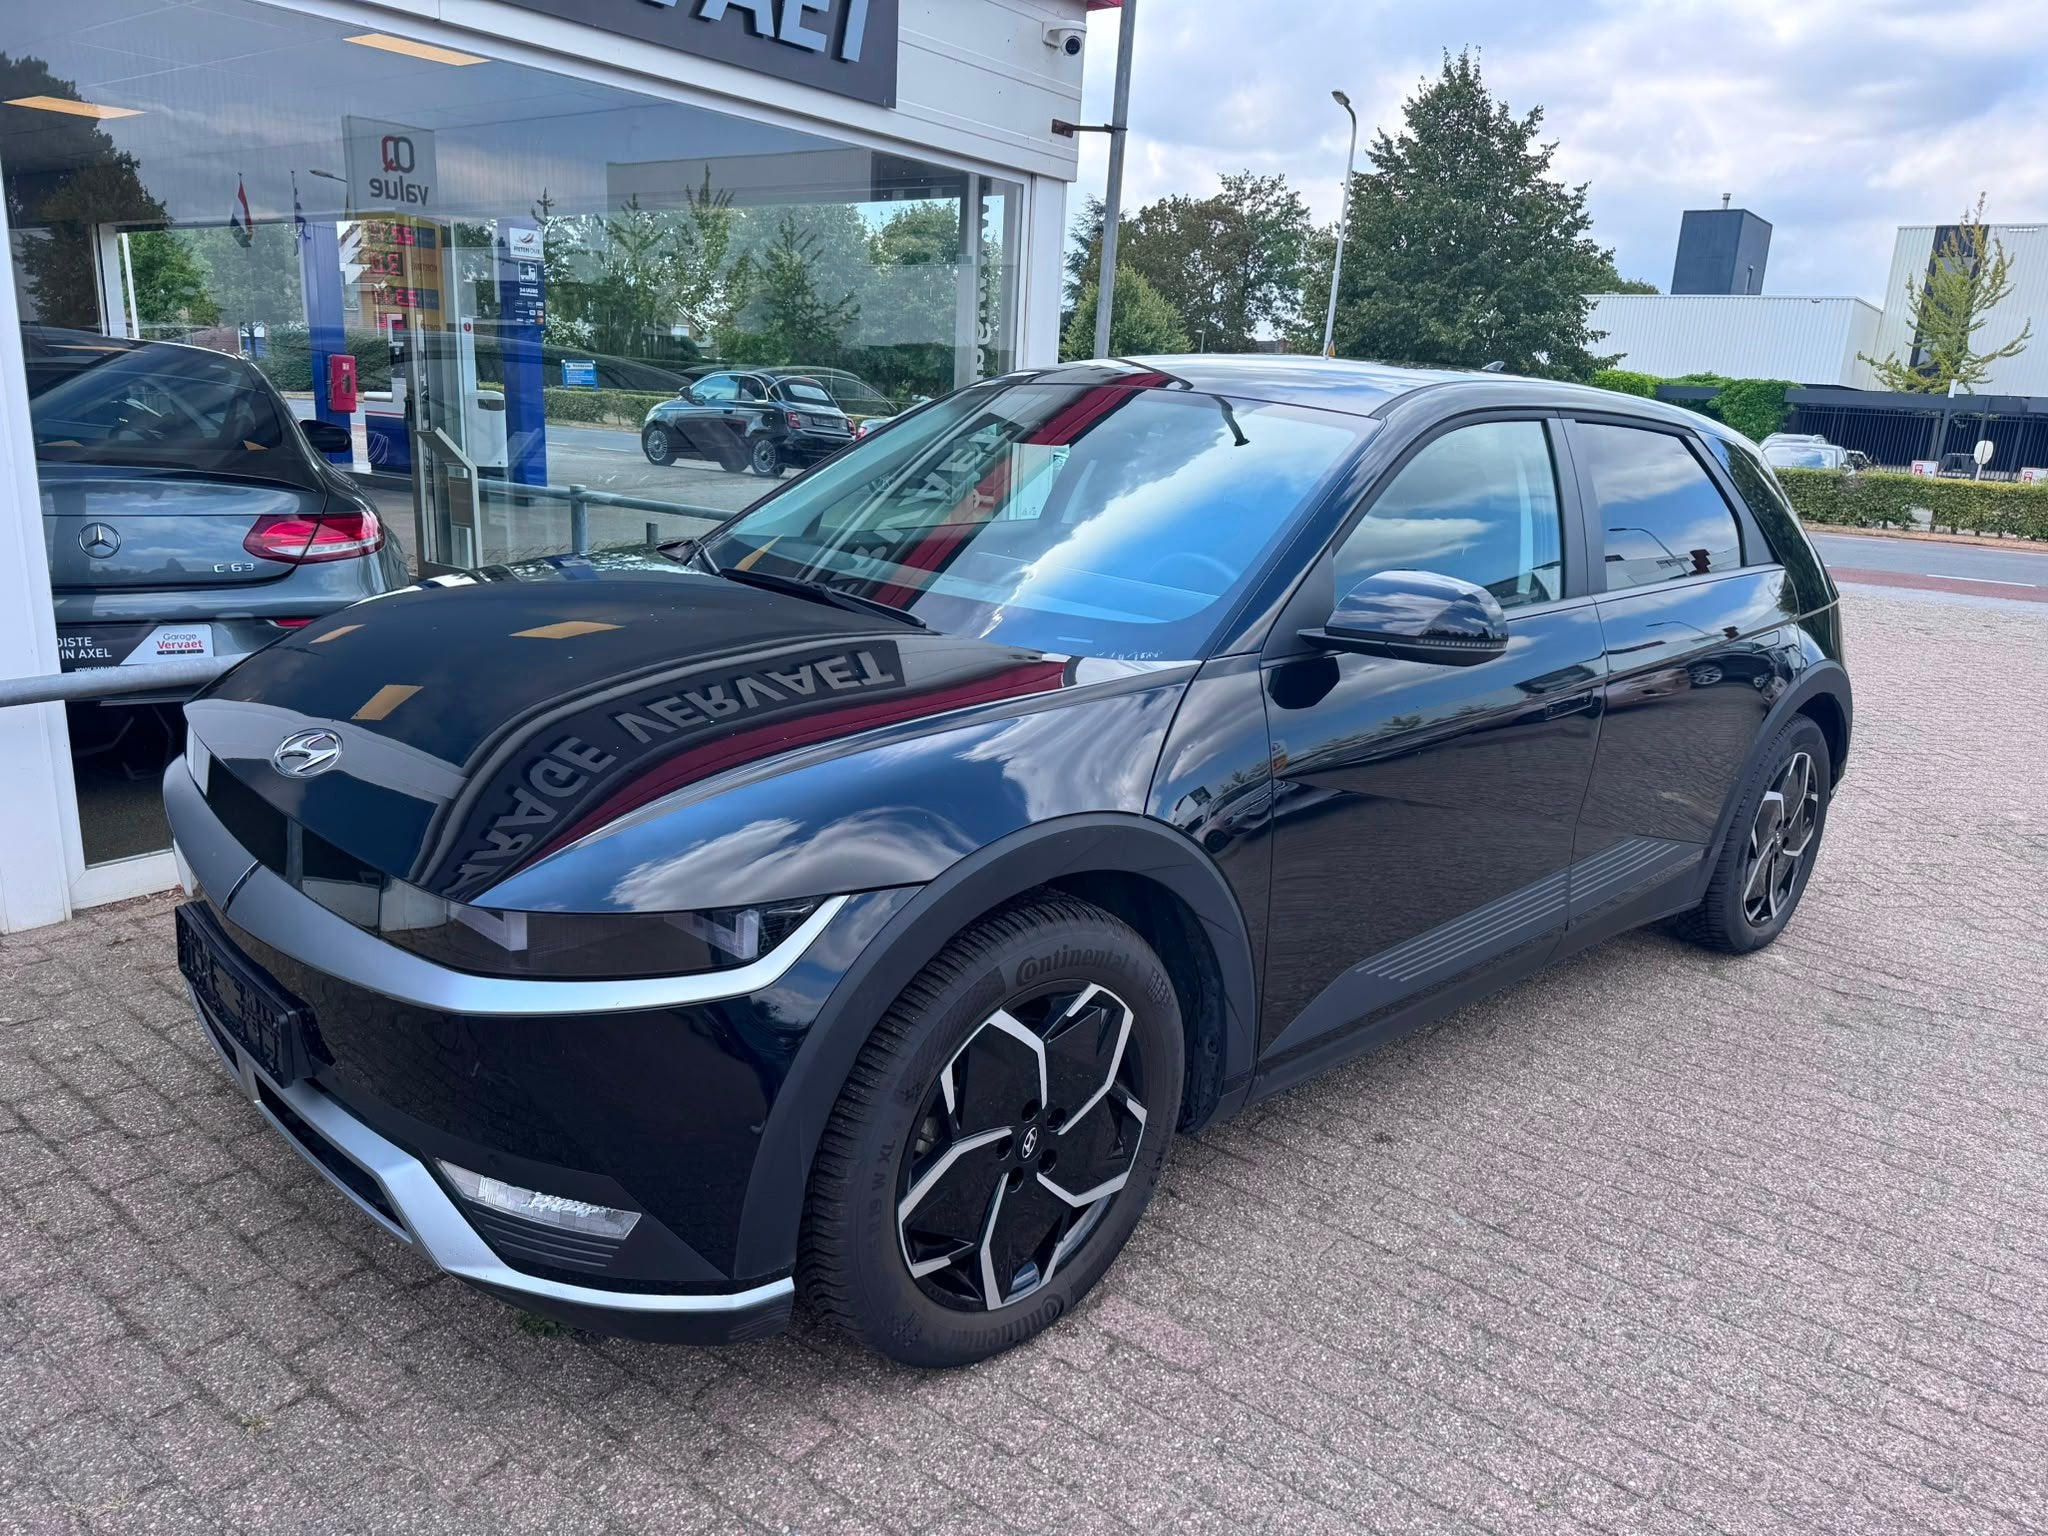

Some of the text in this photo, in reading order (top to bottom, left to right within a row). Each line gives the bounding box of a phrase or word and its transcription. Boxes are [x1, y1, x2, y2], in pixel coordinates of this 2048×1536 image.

[213, 562, 256, 573] C 63
[163, 632, 197, 641] Garage
[156, 640, 203, 650] Vervaet
[61, 647, 113, 660] IN AXEL
[1016, 944, 1131, 988] Continental
